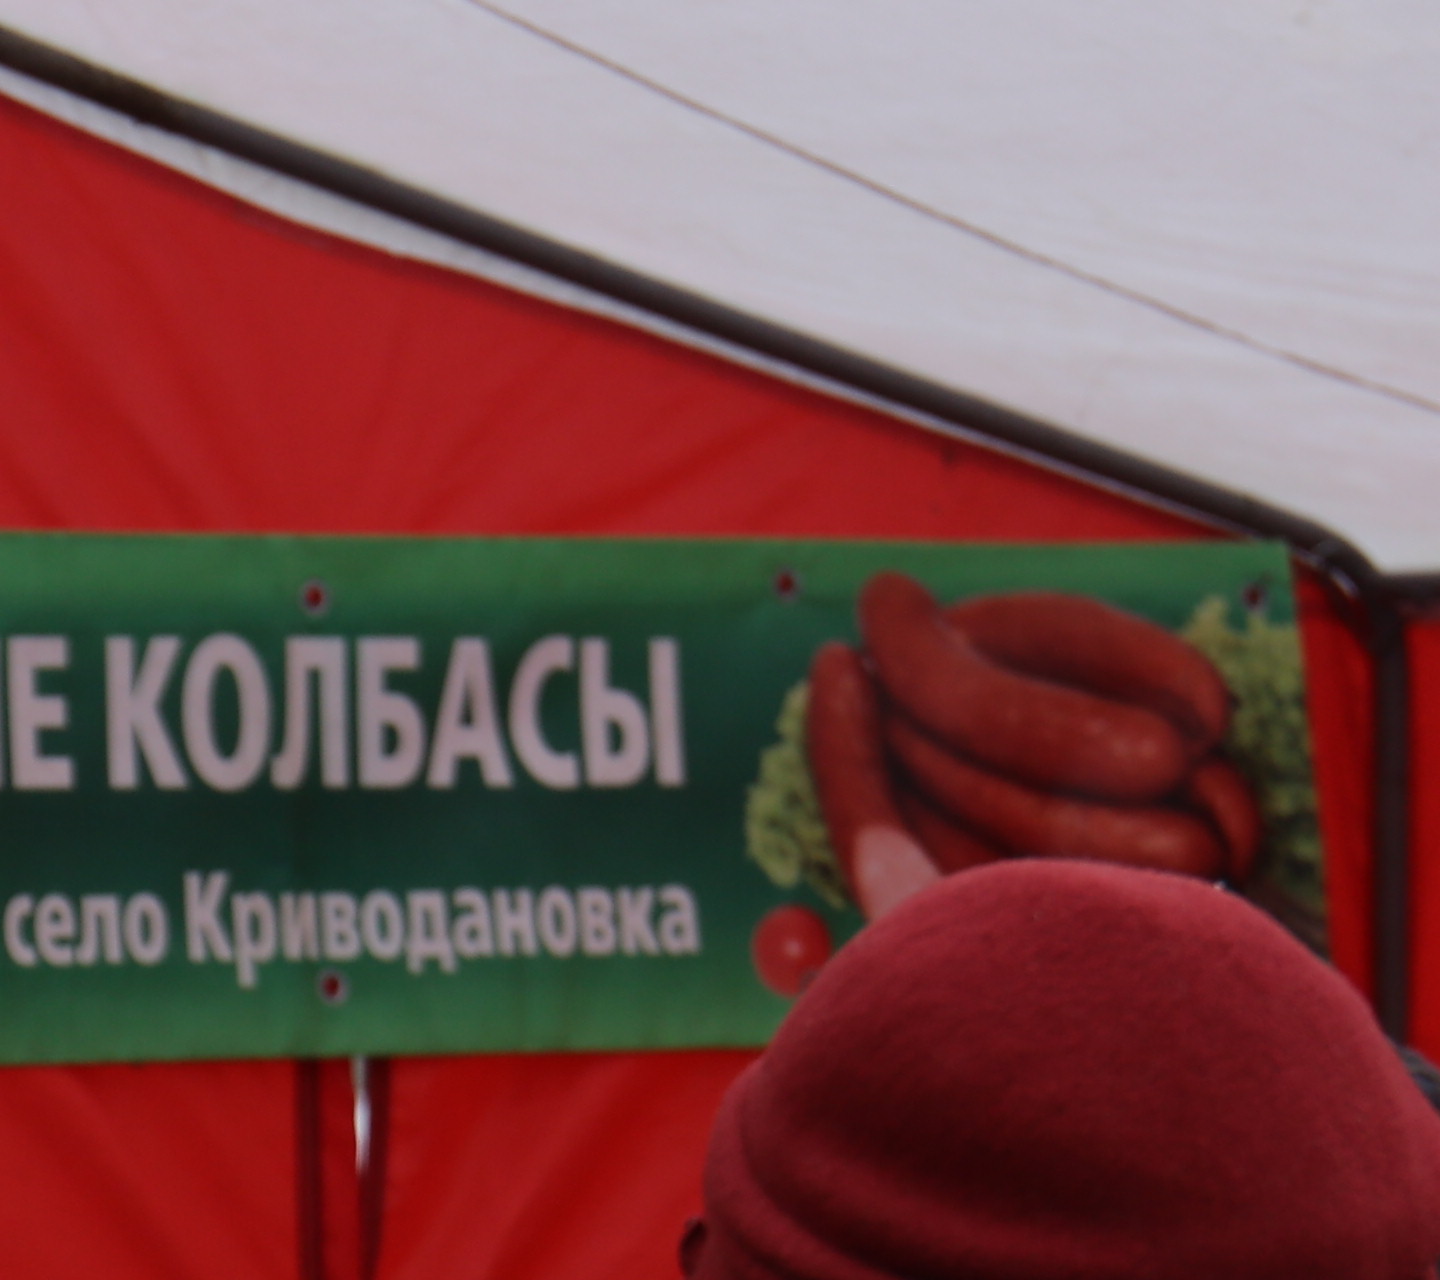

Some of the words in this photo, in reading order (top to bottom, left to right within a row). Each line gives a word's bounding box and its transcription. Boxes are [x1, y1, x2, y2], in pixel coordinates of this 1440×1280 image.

[105, 633, 687, 792] КОЛБАСЫ
[2, 888, 169, 966] село
[184, 871, 701, 987] Криводановка
